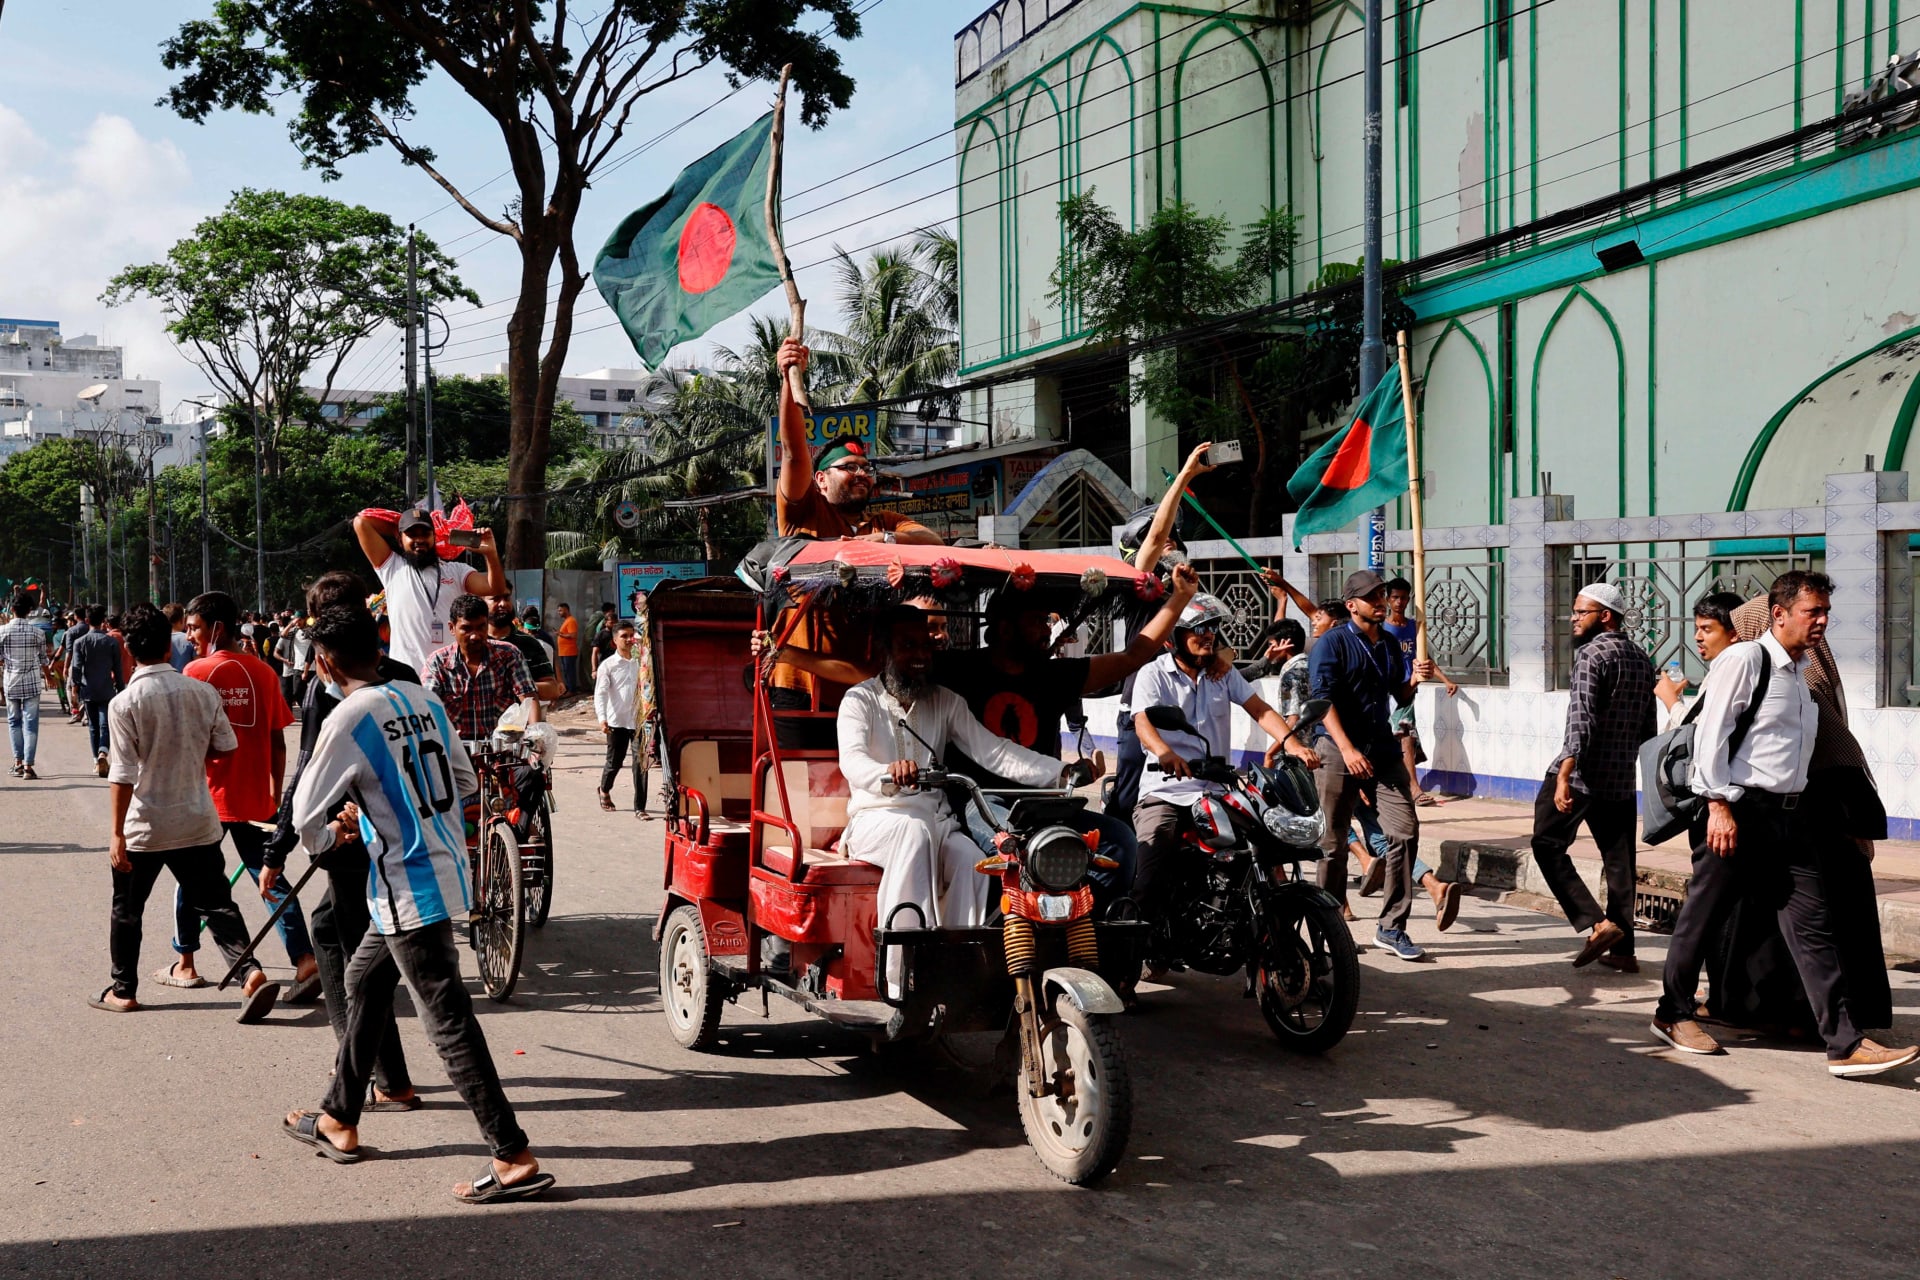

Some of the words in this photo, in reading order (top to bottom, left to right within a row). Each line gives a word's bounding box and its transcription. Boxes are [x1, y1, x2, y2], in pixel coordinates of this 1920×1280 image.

[821, 414, 869, 438] CAR
[1009, 460, 1049, 477] TALH
[234, 687, 249, 698] নতুন
[383, 712, 437, 741] SIAM
[402, 739, 454, 819] 10
